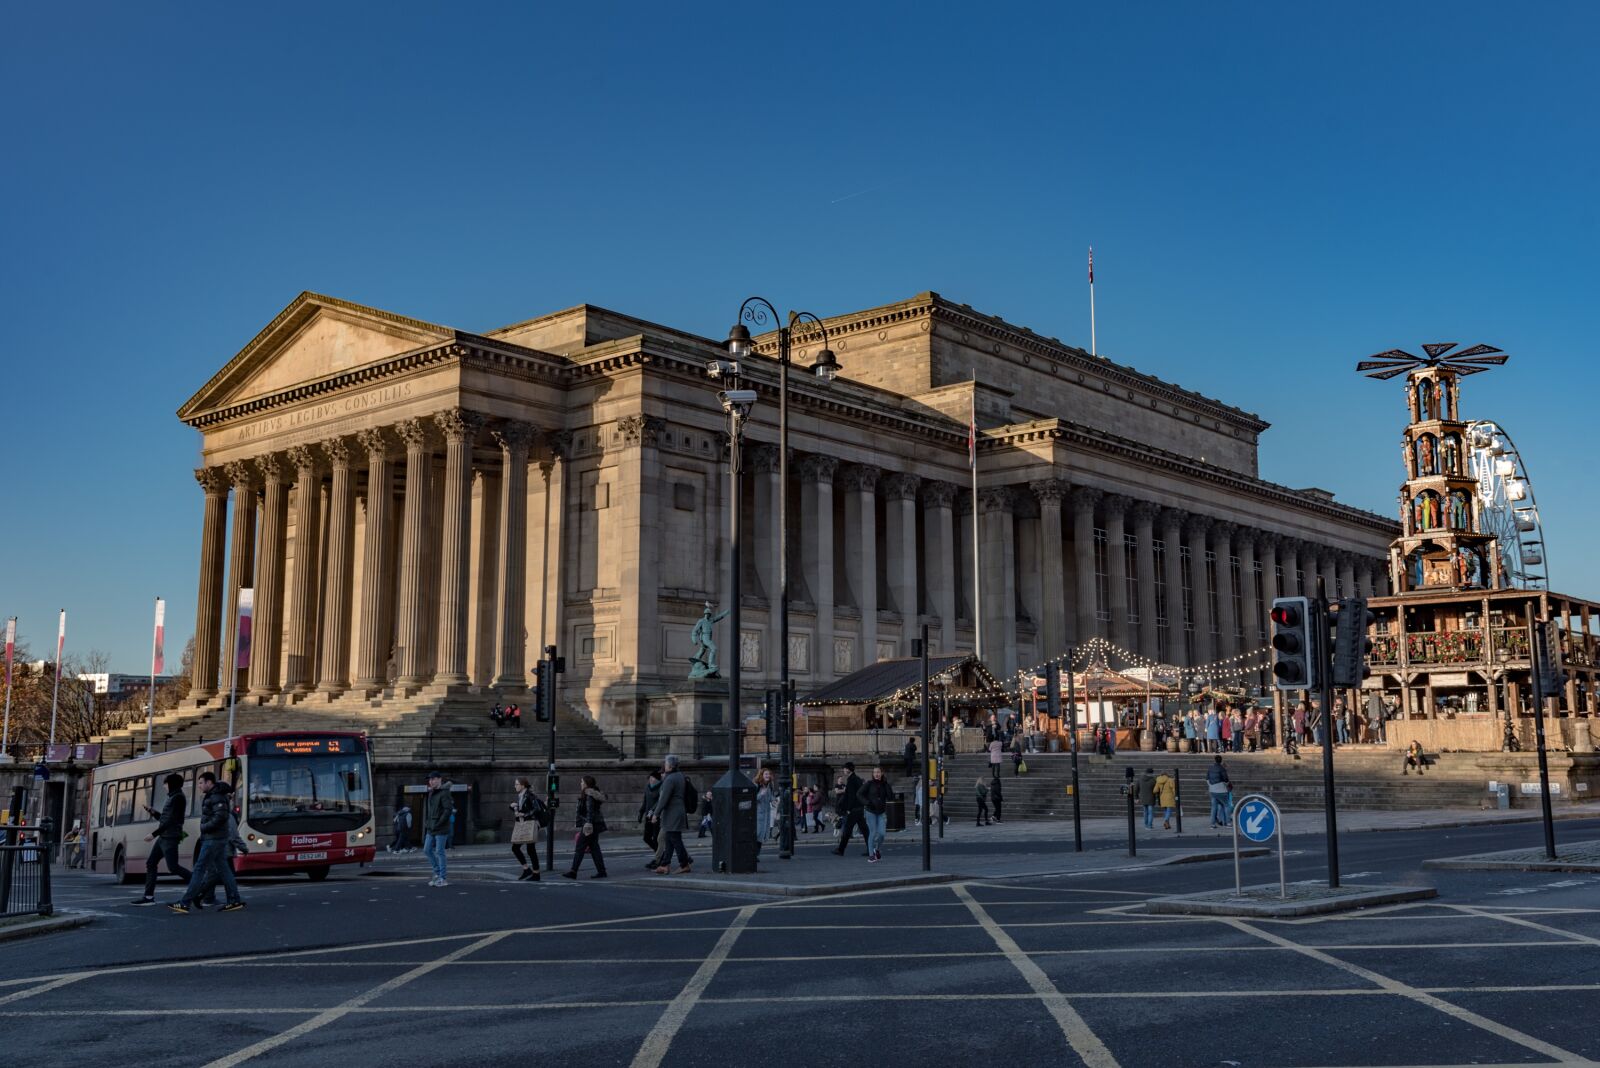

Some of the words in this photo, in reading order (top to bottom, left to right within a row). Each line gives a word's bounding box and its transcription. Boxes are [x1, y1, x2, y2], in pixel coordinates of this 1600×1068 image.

[238, 417, 283, 441] ARTIBVS
[289, 404, 337, 426] LEGIBVS
[345, 383, 412, 411] CONSILIIS
[292, 835, 318, 844] Halton
[344, 849, 354, 857] 34
